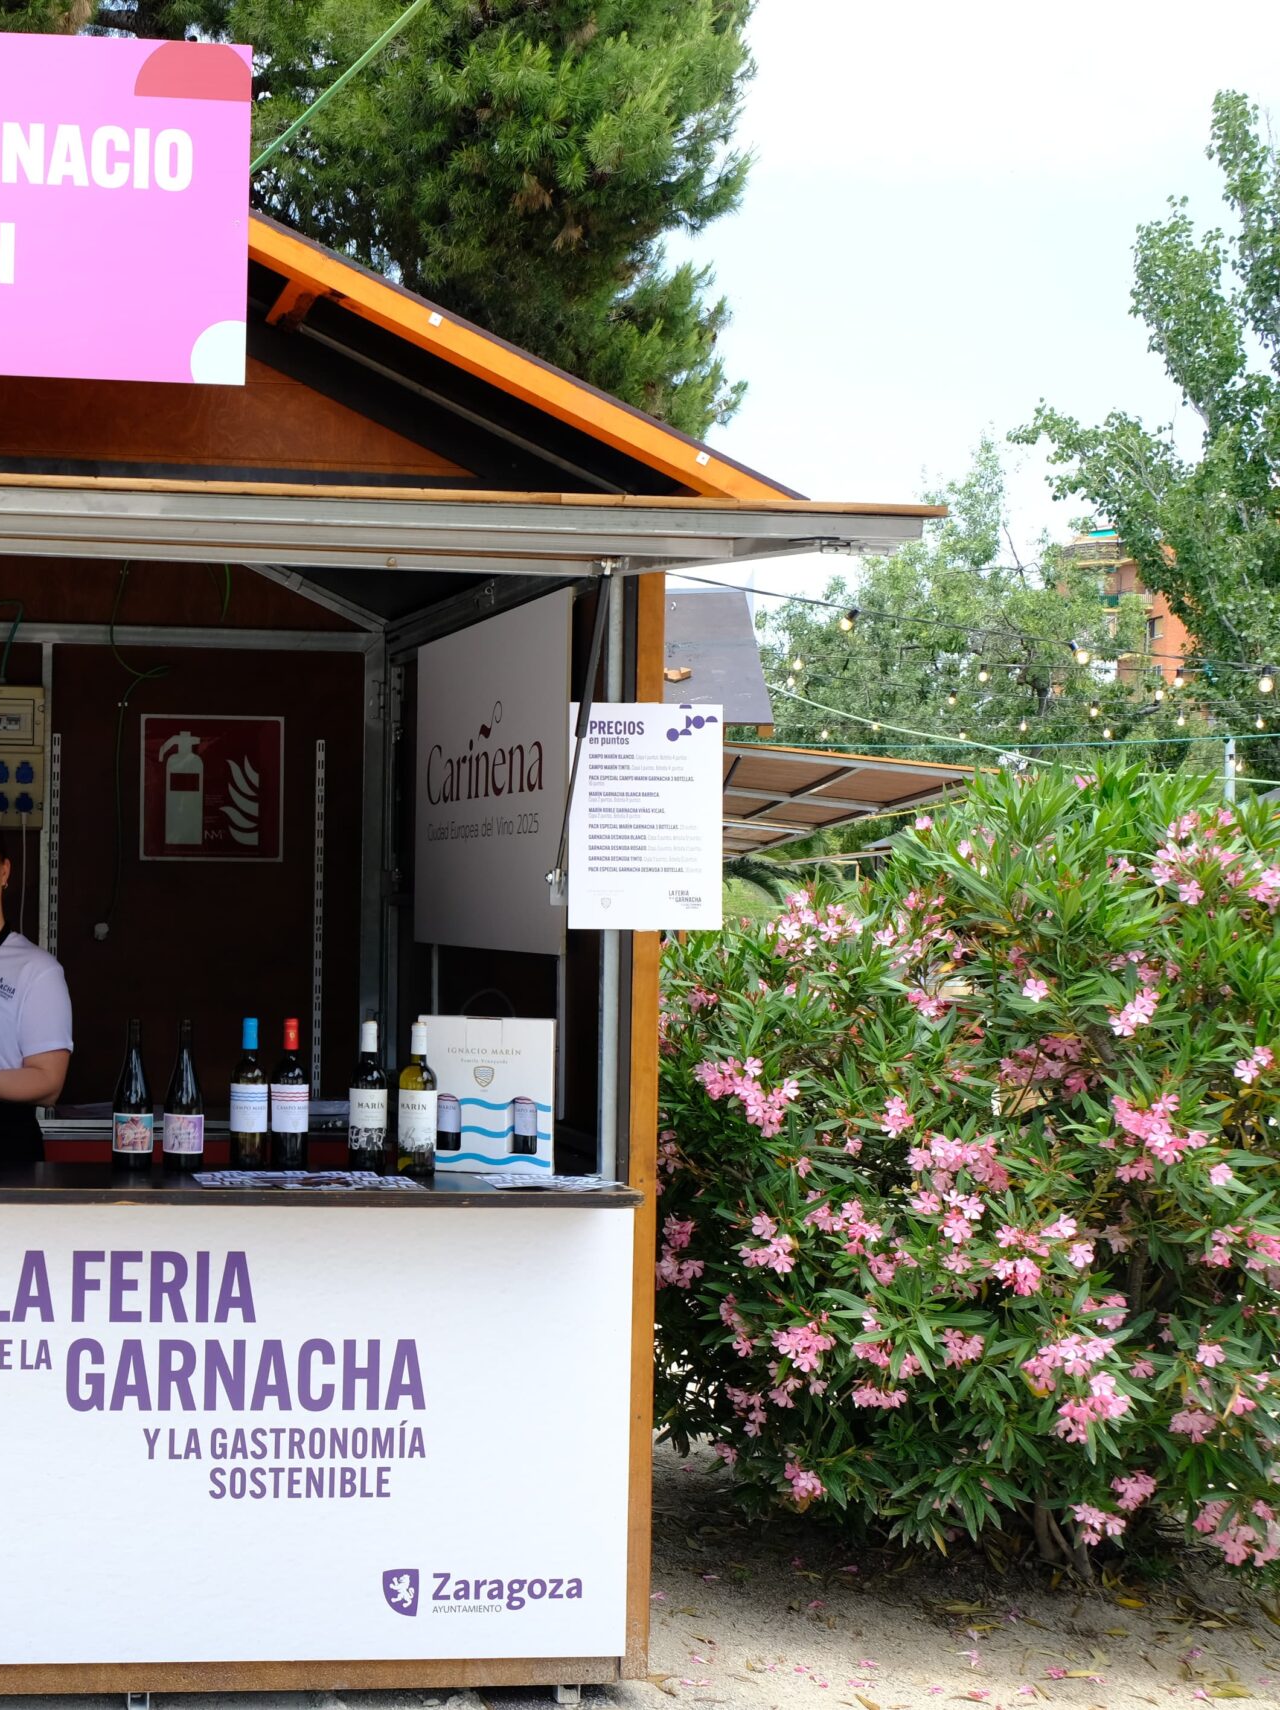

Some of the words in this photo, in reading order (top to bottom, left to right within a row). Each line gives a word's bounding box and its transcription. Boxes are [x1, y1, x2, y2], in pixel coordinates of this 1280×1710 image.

[589, 720, 645, 735] PRECIOS
[589, 736, 599, 745] en
[601, 736, 630, 747] puntos
[427, 700, 544, 806] Cariñena
[427, 820, 449, 841] Ciudad
[451, 820, 479, 843] Europea
[481, 817, 494, 838] del
[496, 815, 513, 836] Vino
[517, 813, 539, 835] 2025
[447, 1047, 487, 1055] IGNACIO
[491, 1047, 521, 1055] MARÍN
[70, 1250, 257, 1323] FERIA
[19, 1339, 53, 1370] LA
[65, 1337, 427, 1412] GARNACHA
[143, 1428, 161, 1460] Y
[168, 1428, 202, 1460] LA
[209, 1420, 426, 1461] GASTRONOMÍA
[208, 1466, 392, 1500] SOSTENIBLE
[431, 1572, 583, 1611] Zaragoza
[432, 1604, 502, 1614] AYUNTAMIENTO
